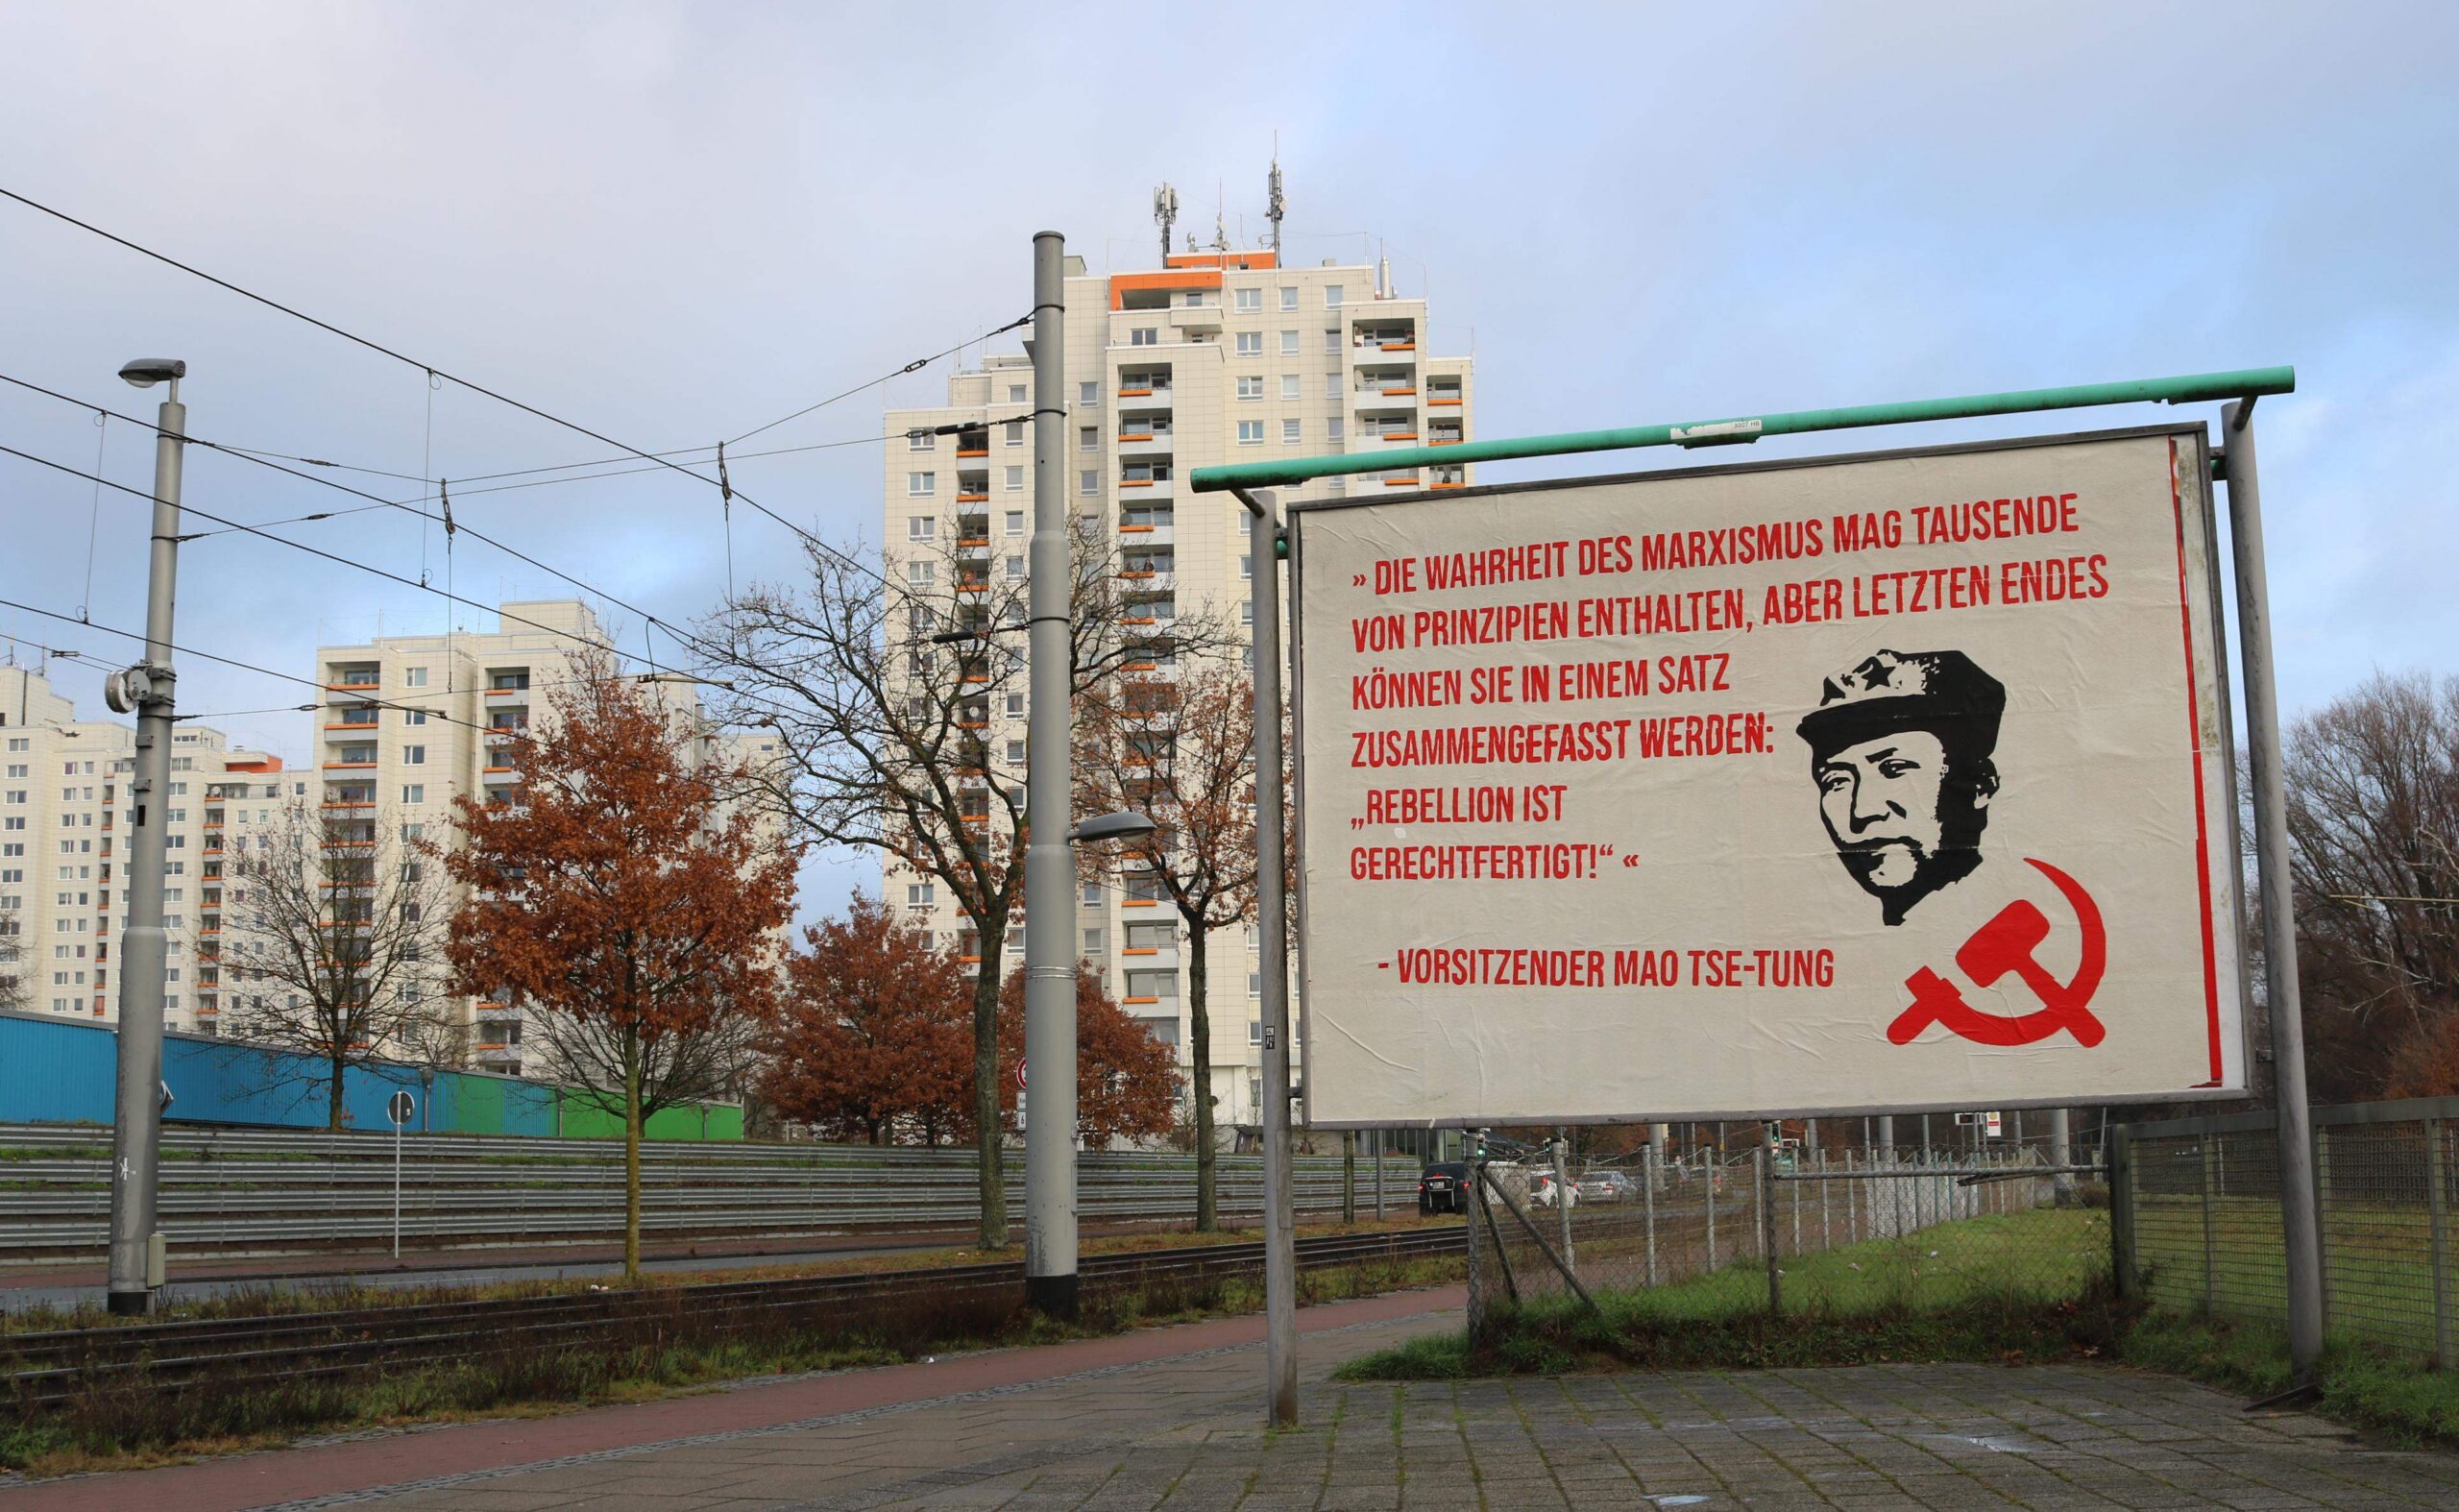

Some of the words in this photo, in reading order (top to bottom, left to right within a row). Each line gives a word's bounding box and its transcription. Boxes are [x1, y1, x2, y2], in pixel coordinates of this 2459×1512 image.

[1375, 557, 1416, 596] DIE
[1424, 541, 1570, 591] WAHRHEIT
[1578, 535, 1634, 576] DES
[1642, 518, 1824, 572] MARXISMUS
[1833, 510, 1903, 553] MAG
[1911, 492, 2080, 545] TAUSENDE
[1351, 615, 1405, 653] VON
[1413, 601, 1569, 647] PRINZIPIEN
[1577, 588, 1753, 639] ENTHALTEN,
[1763, 578, 1843, 626] ABER
[1853, 565, 1991, 618] LETZTEN
[2001, 553, 2109, 605] ENDES
[1352, 667, 1462, 711] KÖNNEN
[1470, 665, 1514, 705] SIE
[1522, 665, 1551, 703] IN
[1559, 659, 1649, 701] EINEM
[1658, 652, 1731, 695] SATZ
[1351, 719, 1632, 768] ZUSAMMENGEFASST
[1640, 711, 1775, 759] WERDEN:
[1522, 784, 1568, 823] IST
[1398, 948, 1605, 988] VORSITZENDER
[1614, 949, 1679, 988] MAO
[1688, 948, 1835, 988] TSE-TUNG
